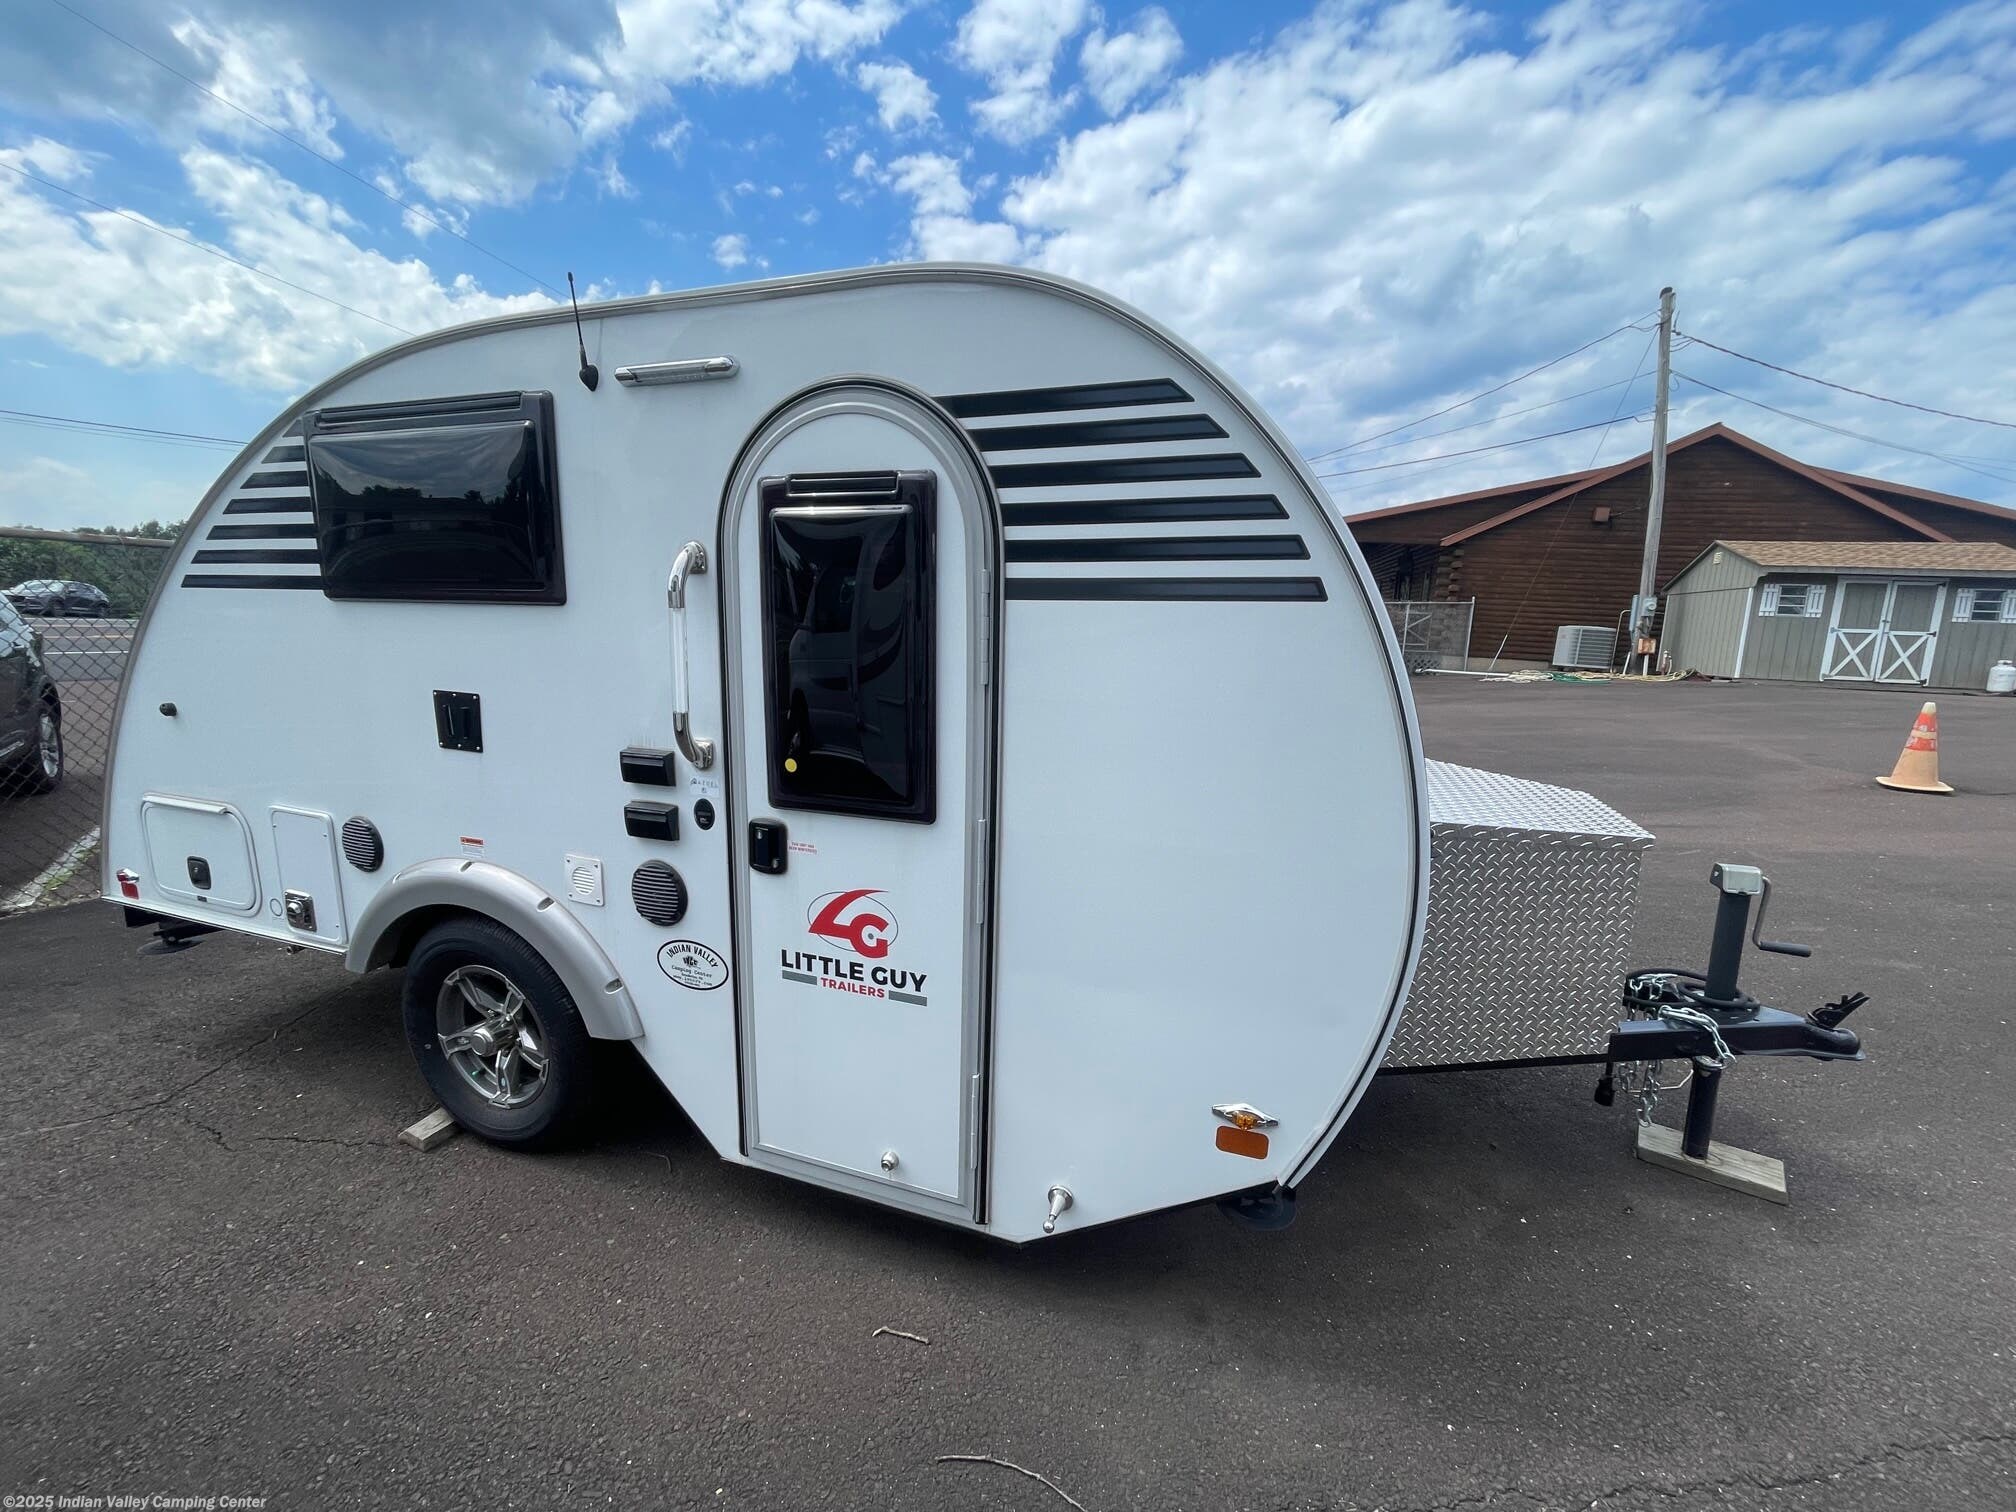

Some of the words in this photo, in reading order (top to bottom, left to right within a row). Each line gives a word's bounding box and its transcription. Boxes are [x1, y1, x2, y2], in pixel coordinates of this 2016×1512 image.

[666, 944, 691, 958] INDIAN
[693, 946, 719, 968] VALLEY
[781, 949, 865, 982] LITTLE
[871, 966, 928, 993] GUY
[820, 977, 885, 999] TRAILERS
